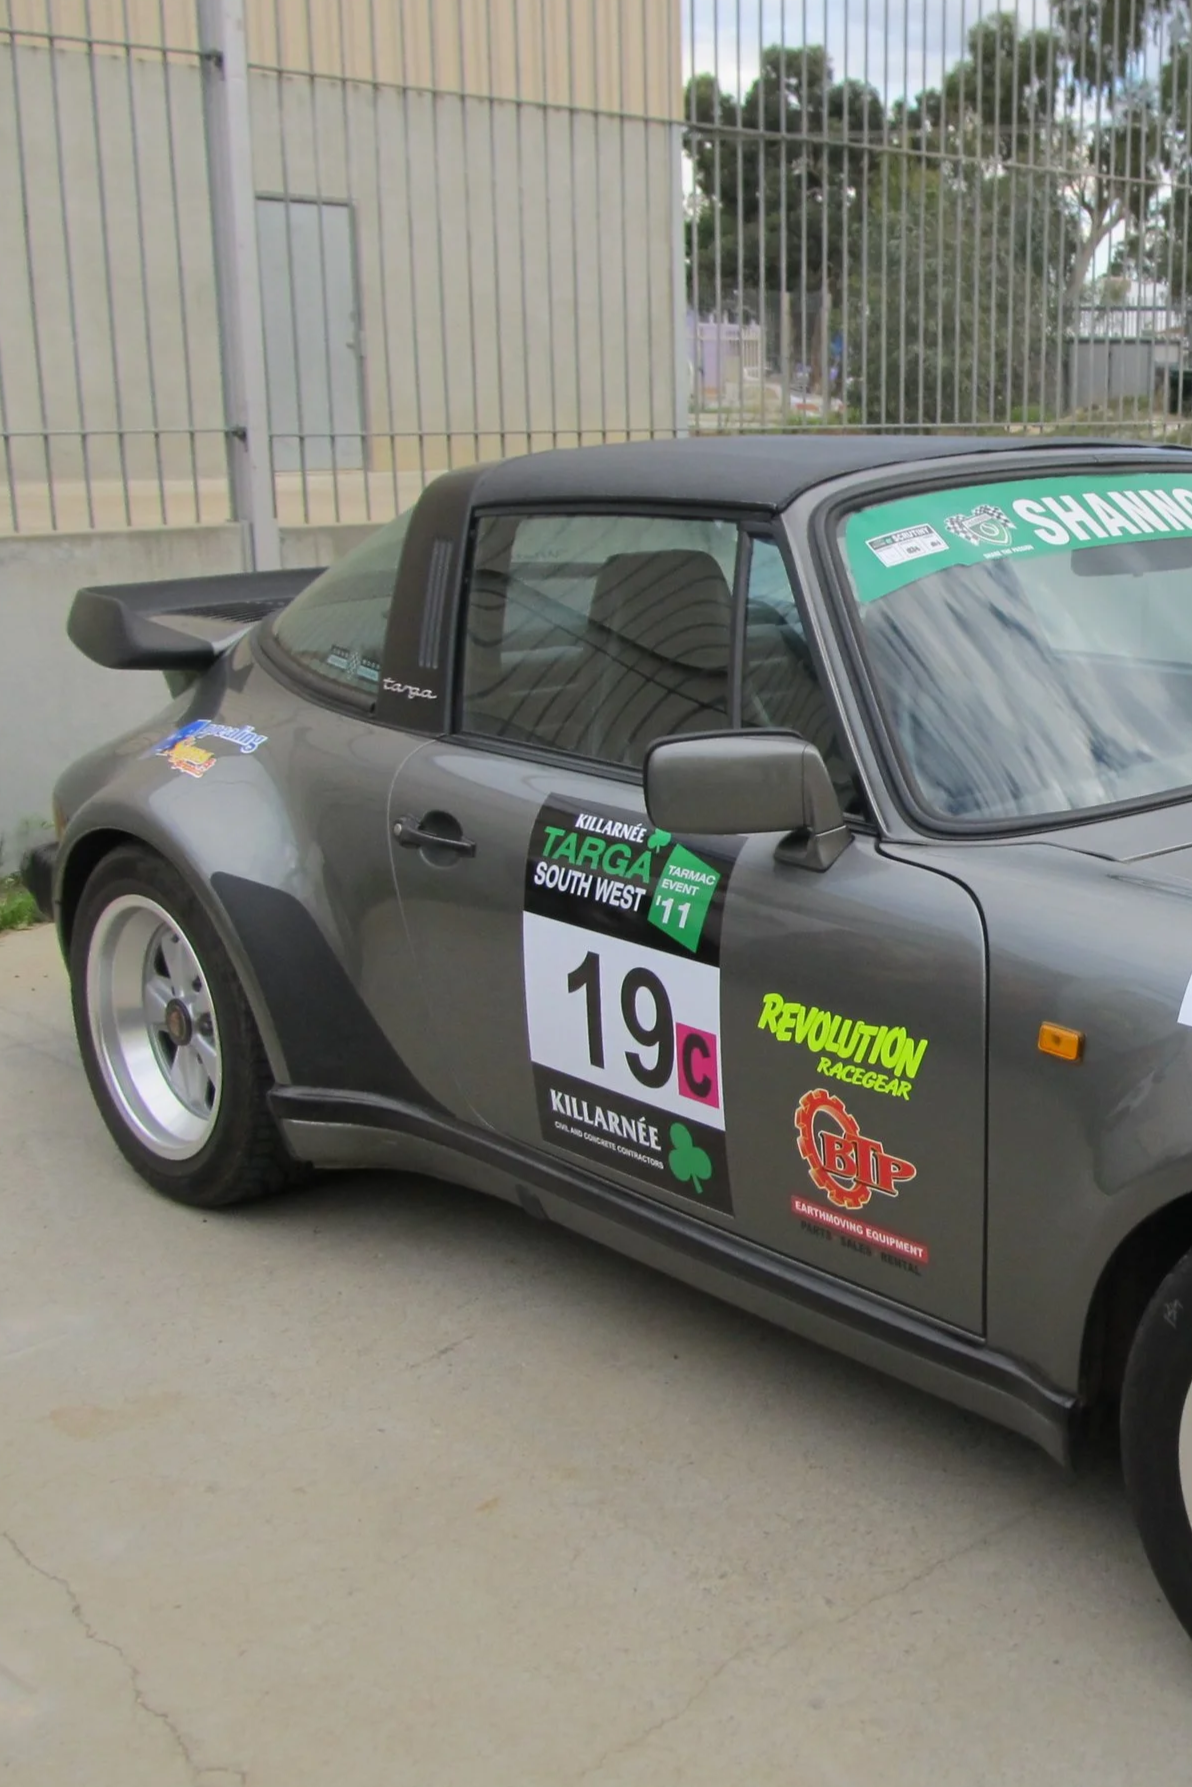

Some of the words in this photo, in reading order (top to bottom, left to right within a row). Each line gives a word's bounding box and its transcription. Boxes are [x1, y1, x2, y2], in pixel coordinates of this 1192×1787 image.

[383, 677, 437, 699] targa
[575, 813, 647, 843] KILLARNÉE
[541, 826, 652, 884] TARGA
[668, 865, 716, 886] TARMAC
[534, 861, 593, 898] SOUTH
[595, 877, 646, 912] WEST
[656, 895, 691, 928] '11
[661, 878, 699, 896] EVENT
[567, 951, 675, 1090] 19
[681, 1033, 712, 1099] C
[758, 993, 928, 1078] REVOLUTION
[817, 1056, 912, 1100] RACEGEAR
[550, 1088, 662, 1151] KILLARNÉE
[554, 1120, 570, 1133] CIVIL
[570, 1127, 583, 1138] AND
[584, 1131, 616, 1151] CONCRETE
[617, 1144, 664, 1170] CONTRACTORS
[818, 1130, 917, 1197] BTP
[795, 1200, 863, 1235] EARTHMOVING
[865, 1228, 923, 1257] EQUIPMENT
[801, 1220, 832, 1240] PARTS
[840, 1237, 872, 1257] SALES
